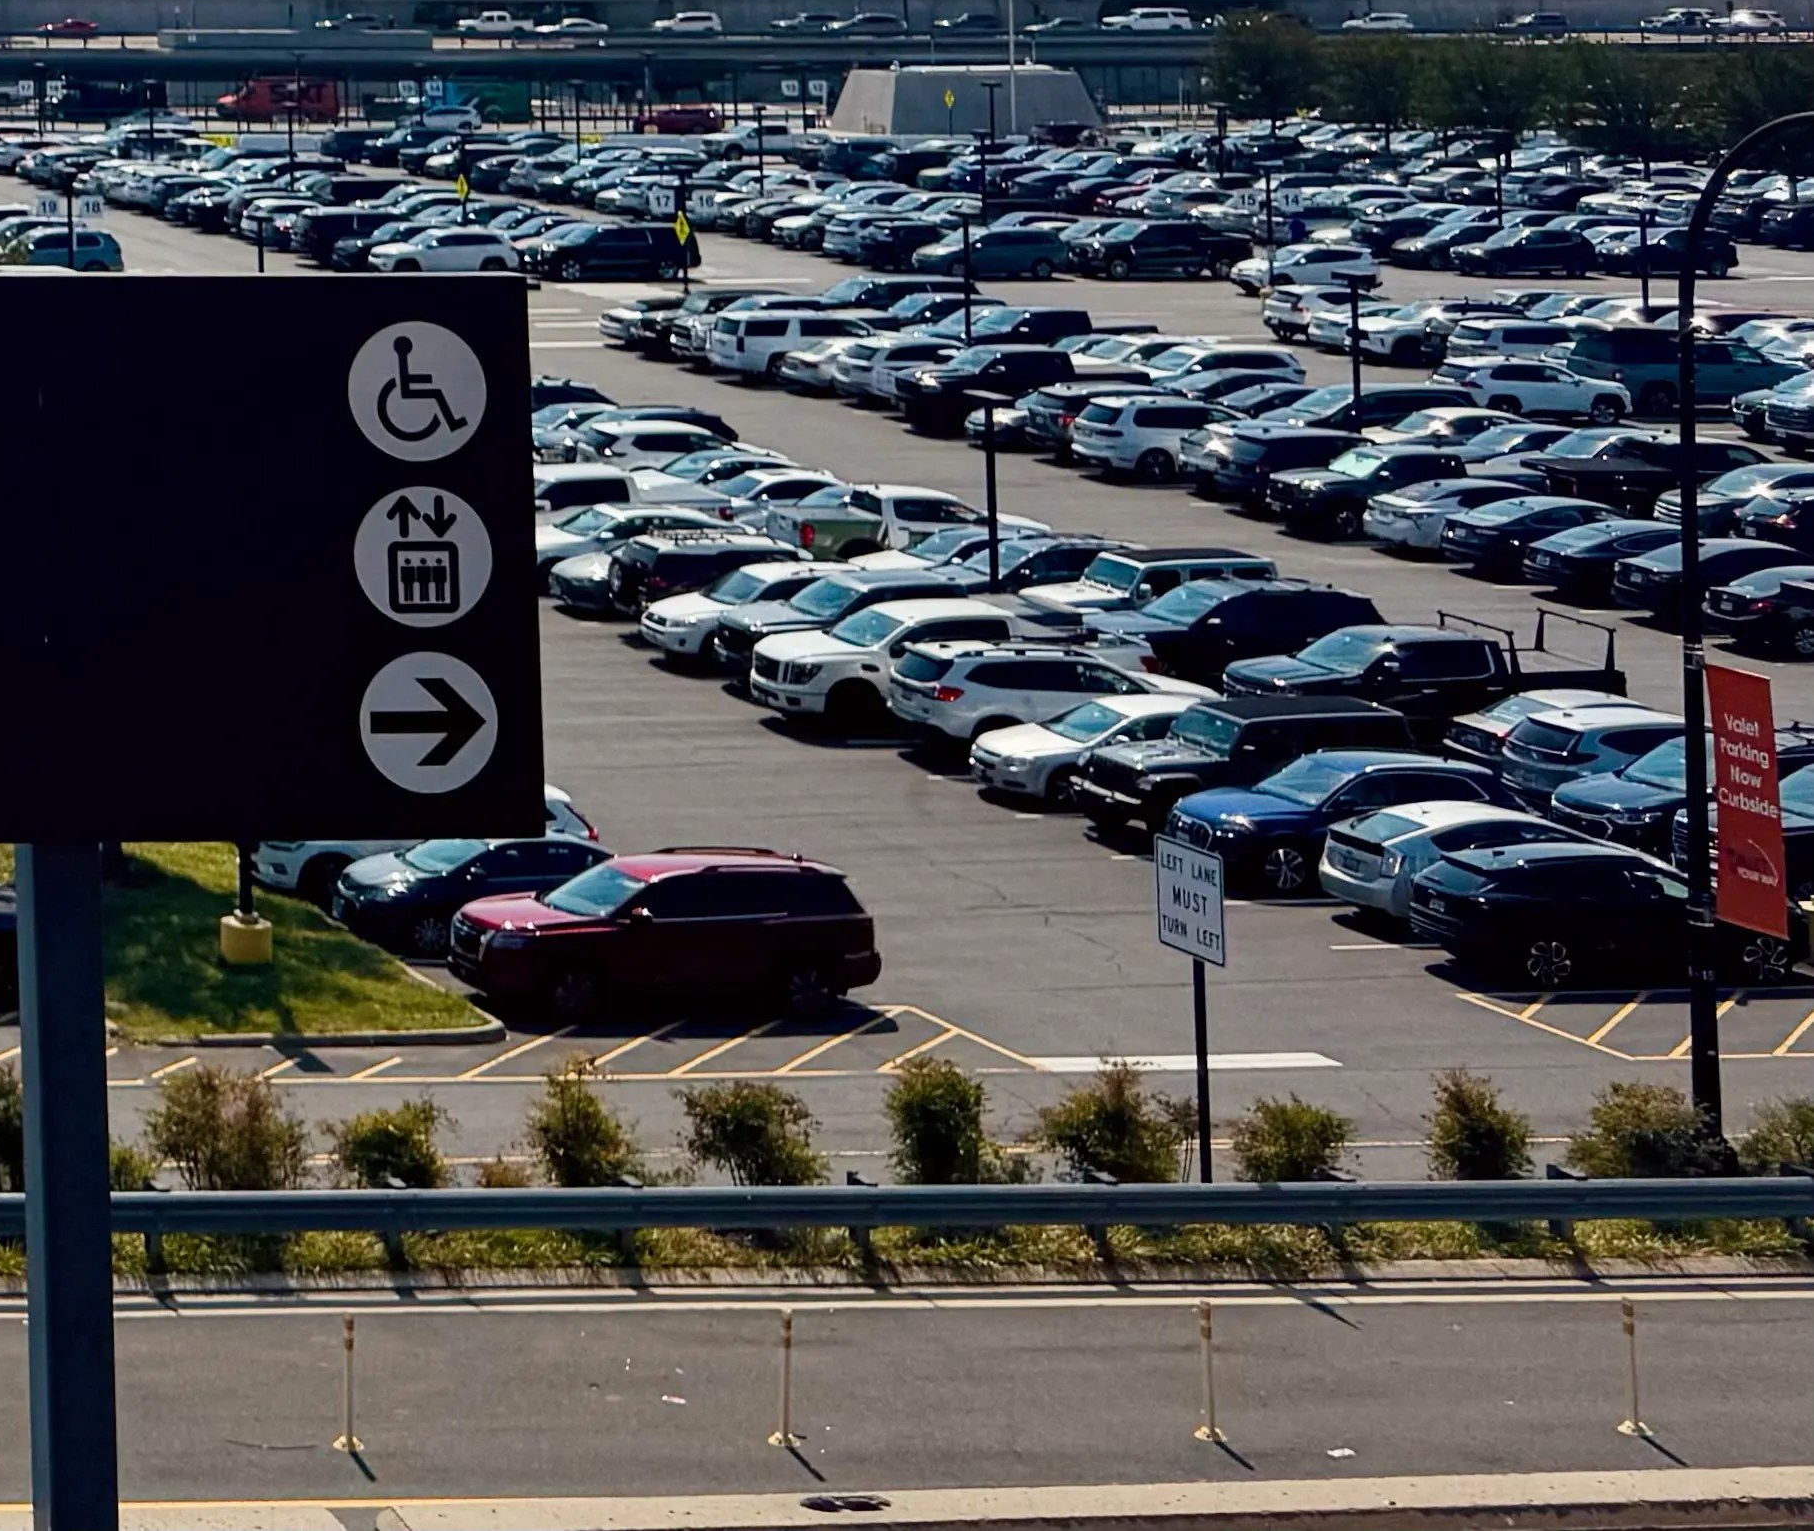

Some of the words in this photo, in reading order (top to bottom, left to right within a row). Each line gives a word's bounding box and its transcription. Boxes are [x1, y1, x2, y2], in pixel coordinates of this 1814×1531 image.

[41, 200, 57, 214] 19
[84, 200, 101, 214] 18
[655, 194, 671, 208] 17
[699, 194, 714, 208] 16
[1240, 194, 1256, 206] 15
[1284, 194, 1299, 207] 14
[1724, 712, 1759, 738] Valet
[1720, 737, 1770, 769] Parking
[1730, 764, 1762, 788] Now
[1718, 787, 1780, 819] Curbside
[1161, 852, 1183, 874] LEFT
[1192, 862, 1217, 887] LANE
[1172, 885, 1207, 917] MUST
[1162, 914, 1187, 938] TURN
[1197, 926, 1220, 950] LEFT
